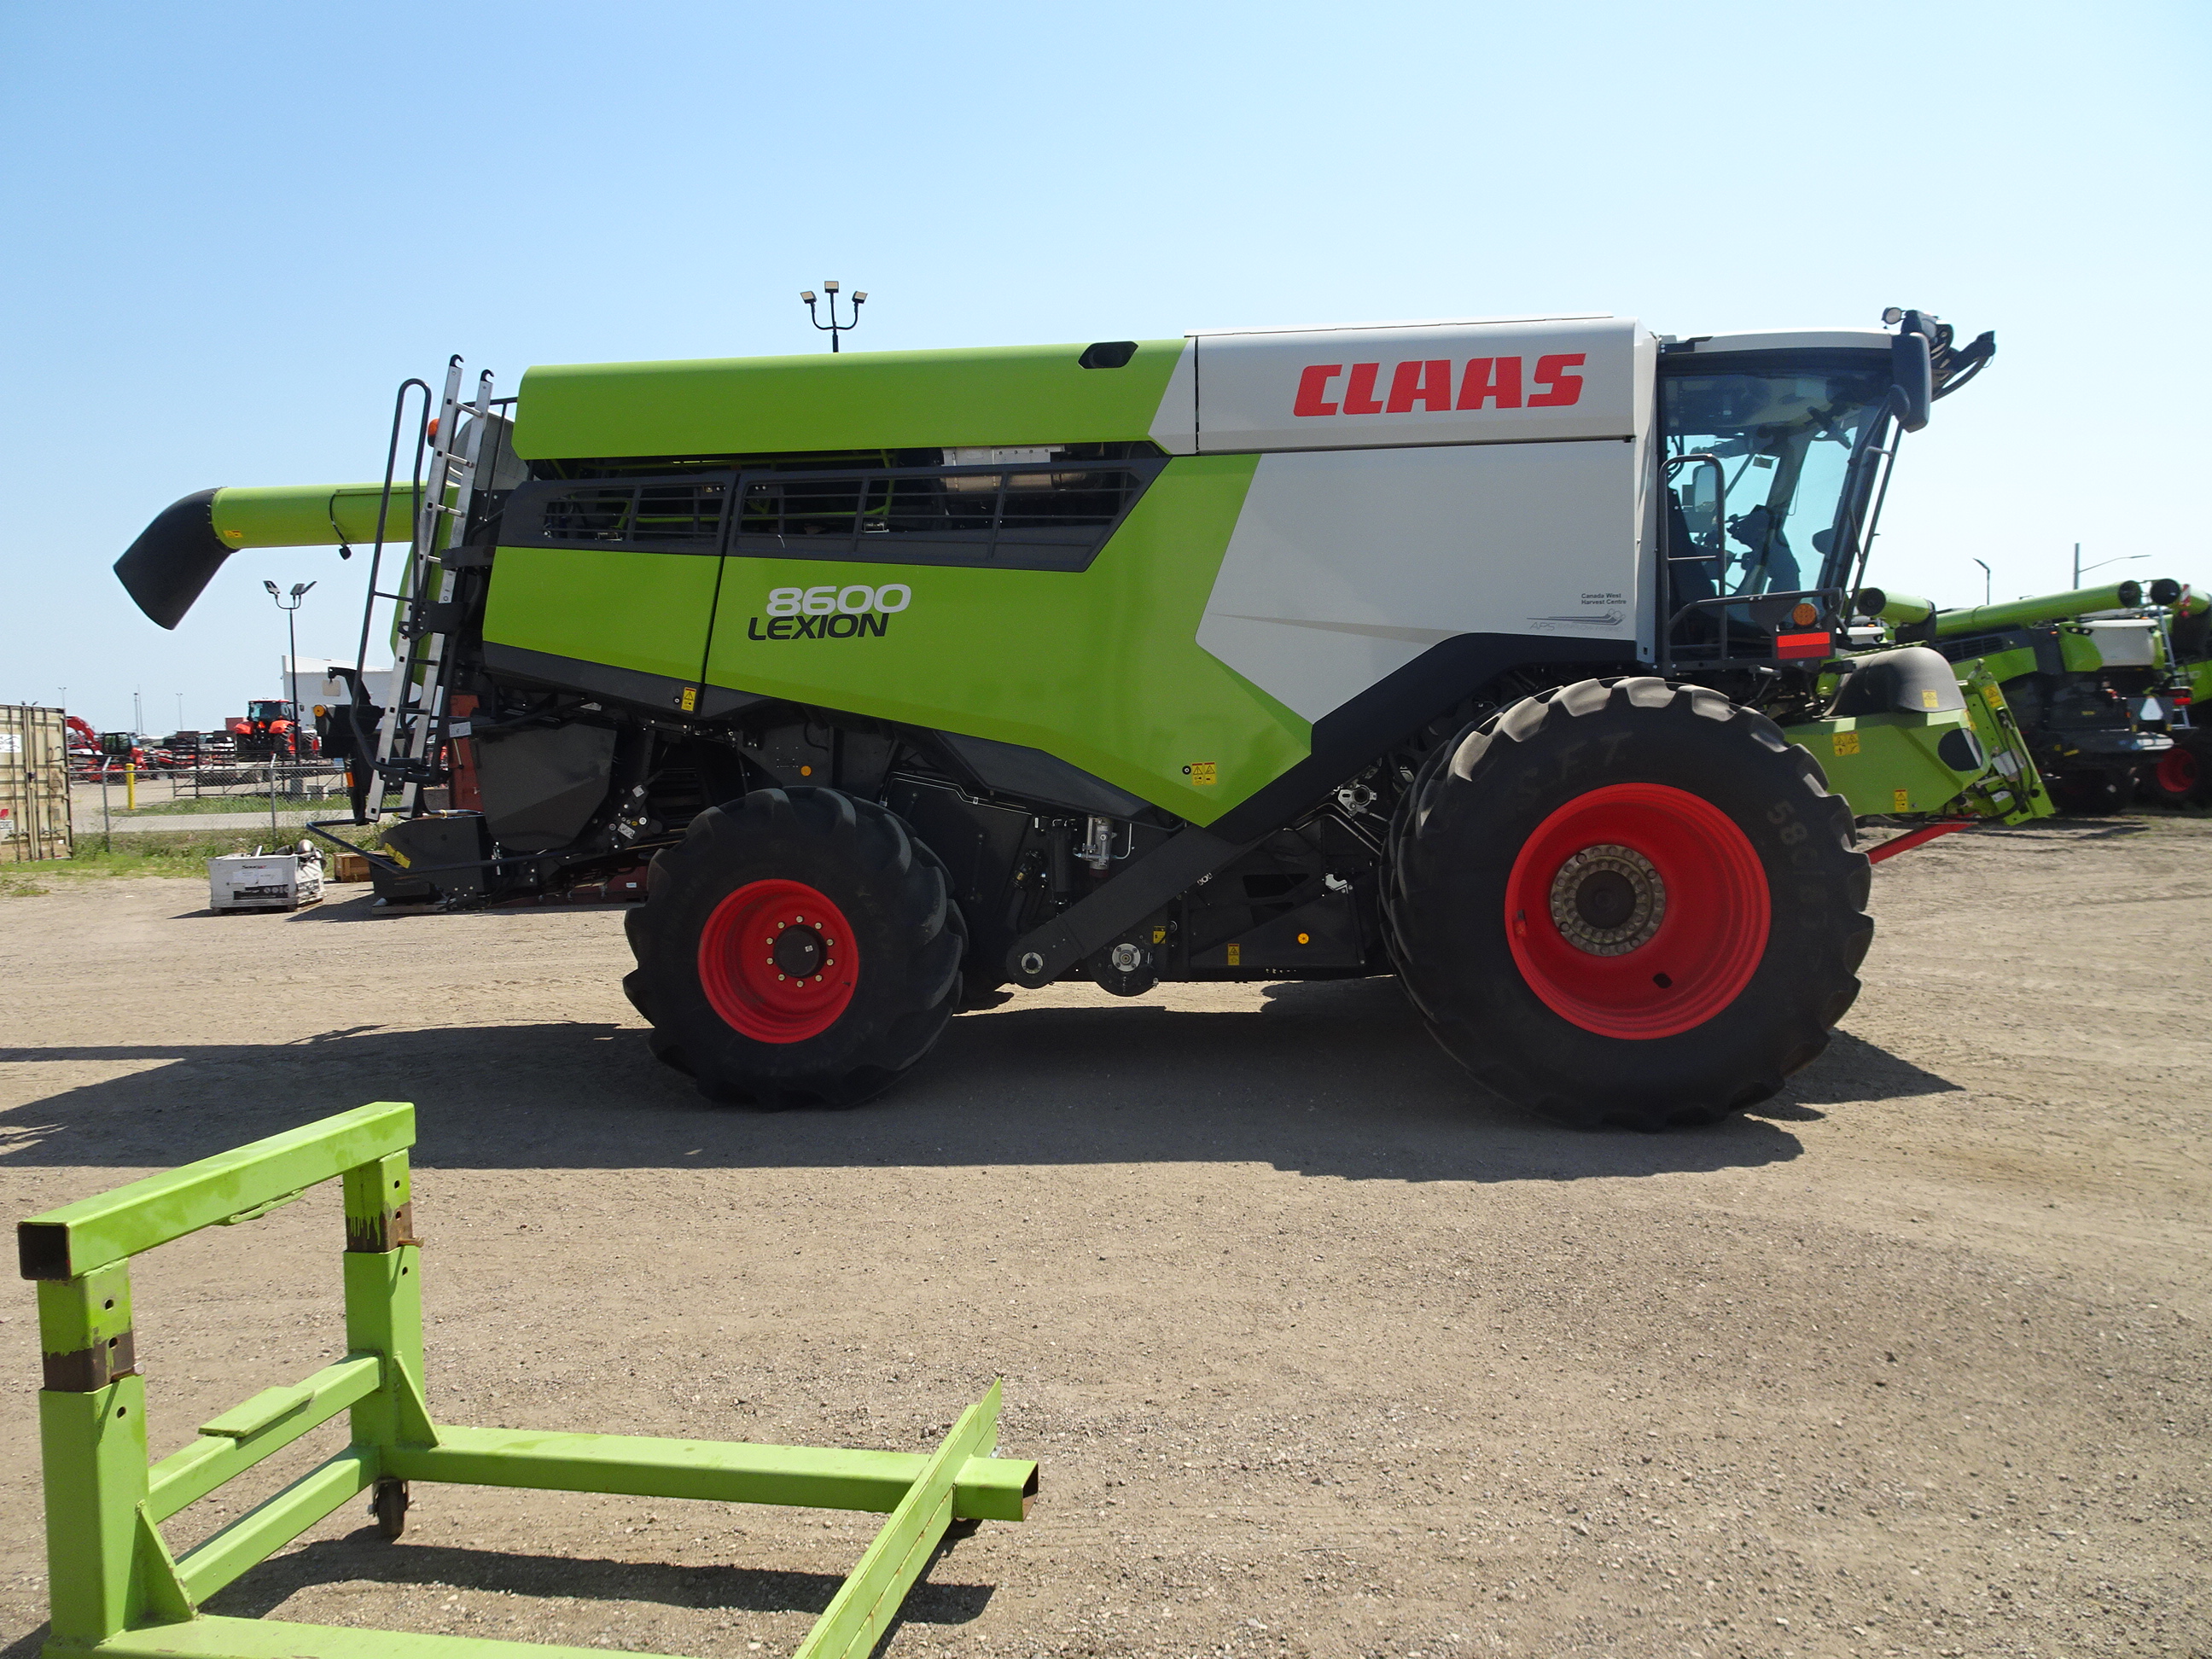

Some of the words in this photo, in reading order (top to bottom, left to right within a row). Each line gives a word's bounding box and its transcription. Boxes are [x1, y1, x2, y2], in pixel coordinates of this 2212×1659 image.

[1293, 352, 1586, 417] CLAAS
[766, 584, 911, 617] 8600
[748, 613, 889, 640] LEXION
[1529, 621, 1556, 632] APS
